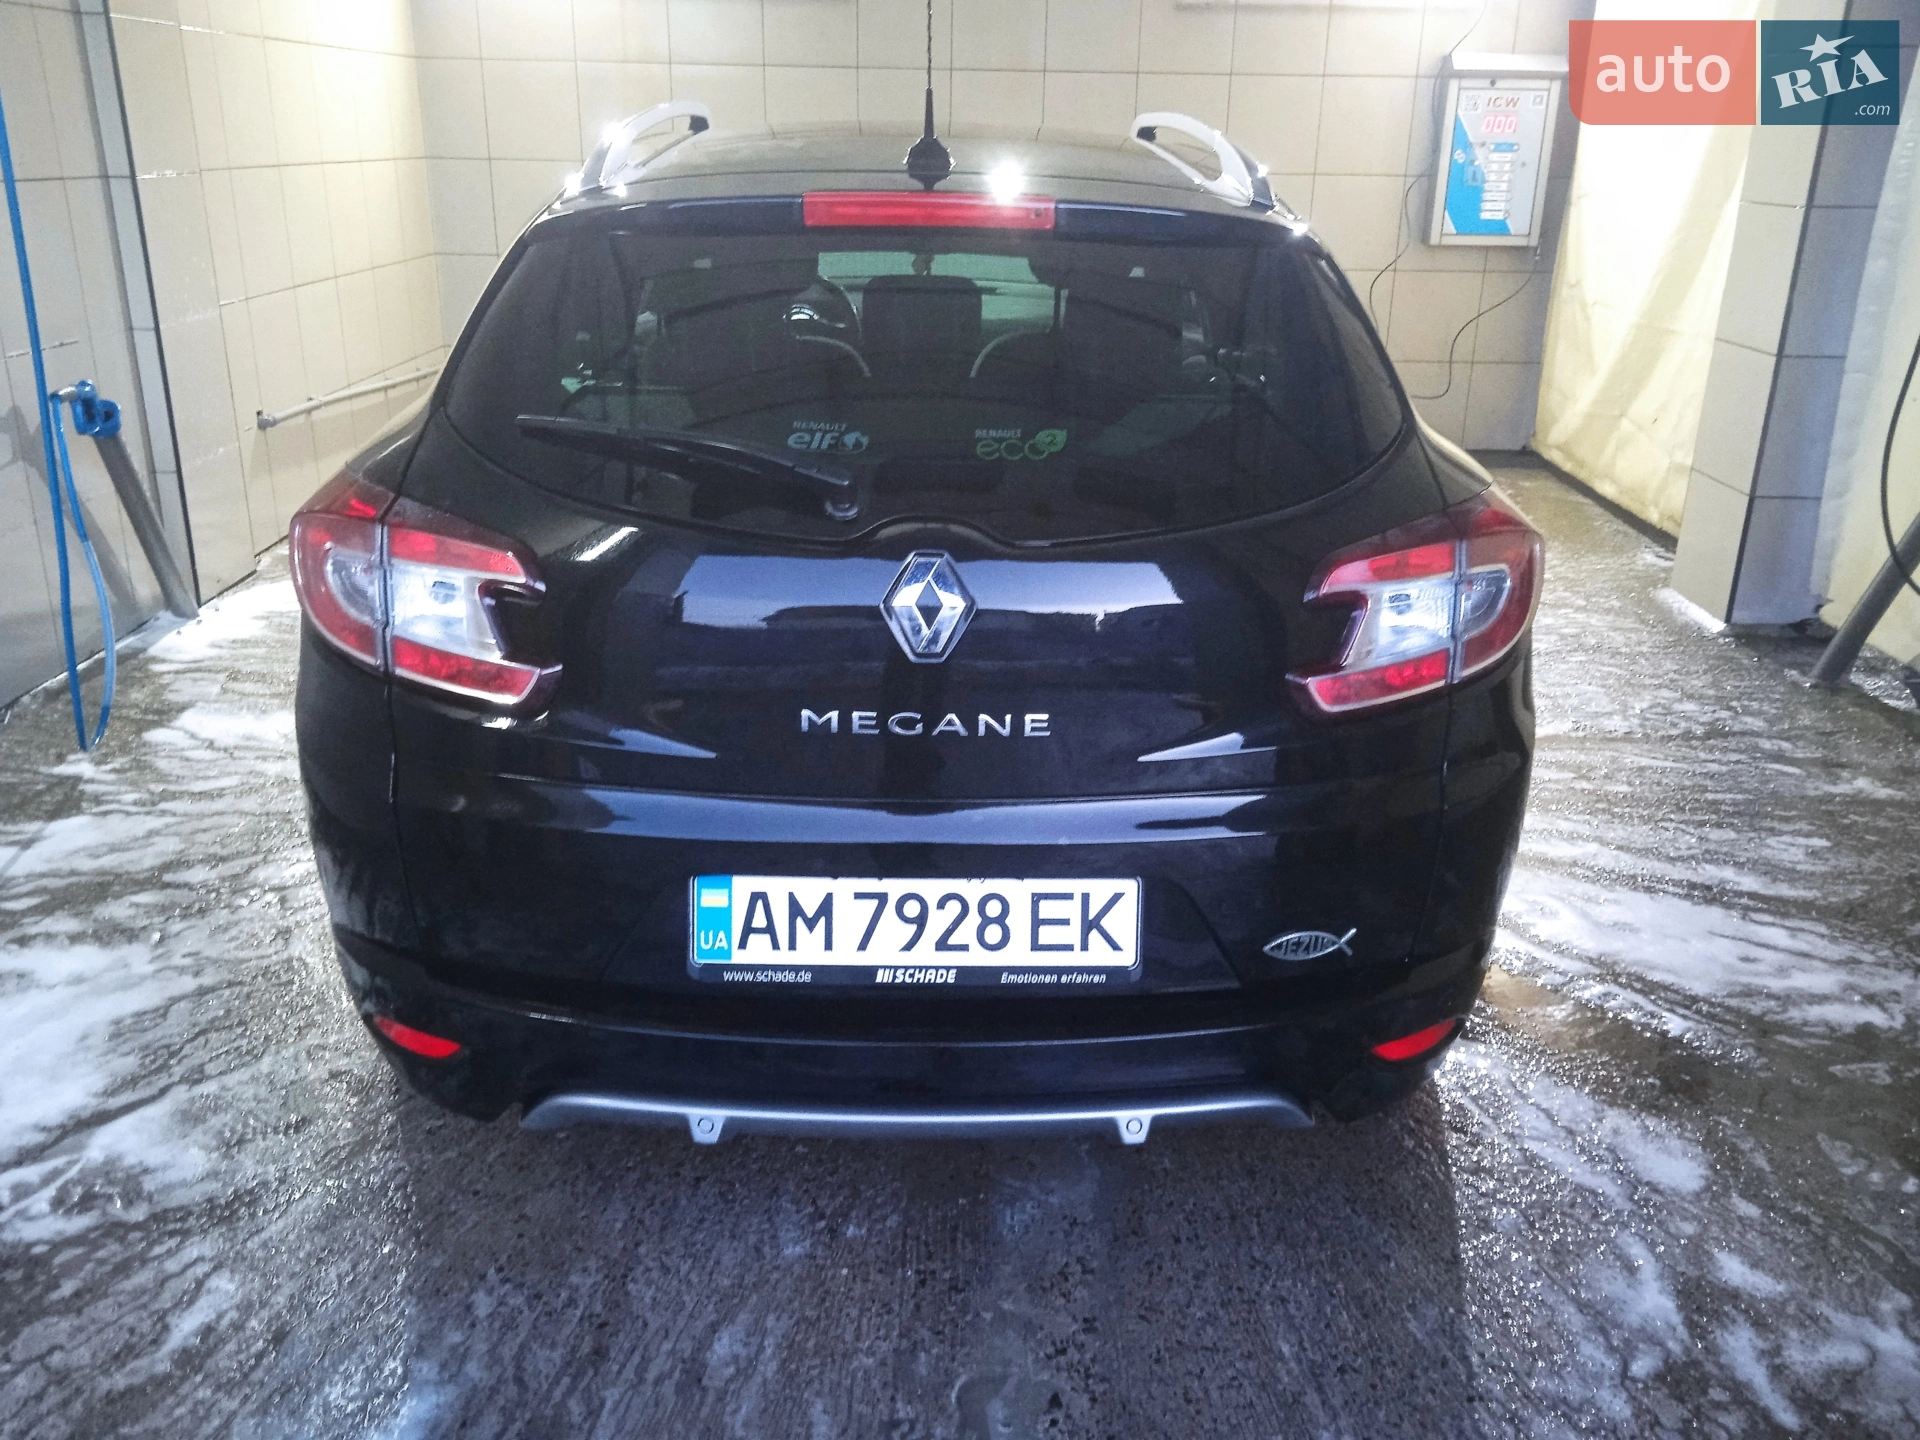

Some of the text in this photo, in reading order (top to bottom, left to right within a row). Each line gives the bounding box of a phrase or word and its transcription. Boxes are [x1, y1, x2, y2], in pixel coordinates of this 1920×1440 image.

[1486, 96, 1520, 109] ICW
[1482, 115, 1517, 133] 000
[793, 420, 847, 432] RENAULT
[975, 428, 1021, 438] RENAULT
[787, 431, 840, 450] elf
[800, 708, 1051, 737] MEGANE
[737, 890, 1126, 953] AM 7928 EK
[700, 930, 729, 950] UA
[723, 970, 812, 983] www.schade.de
[894, 968, 957, 984] SCHADE
[1000, 972, 1106, 984] Emotionen erfahren
